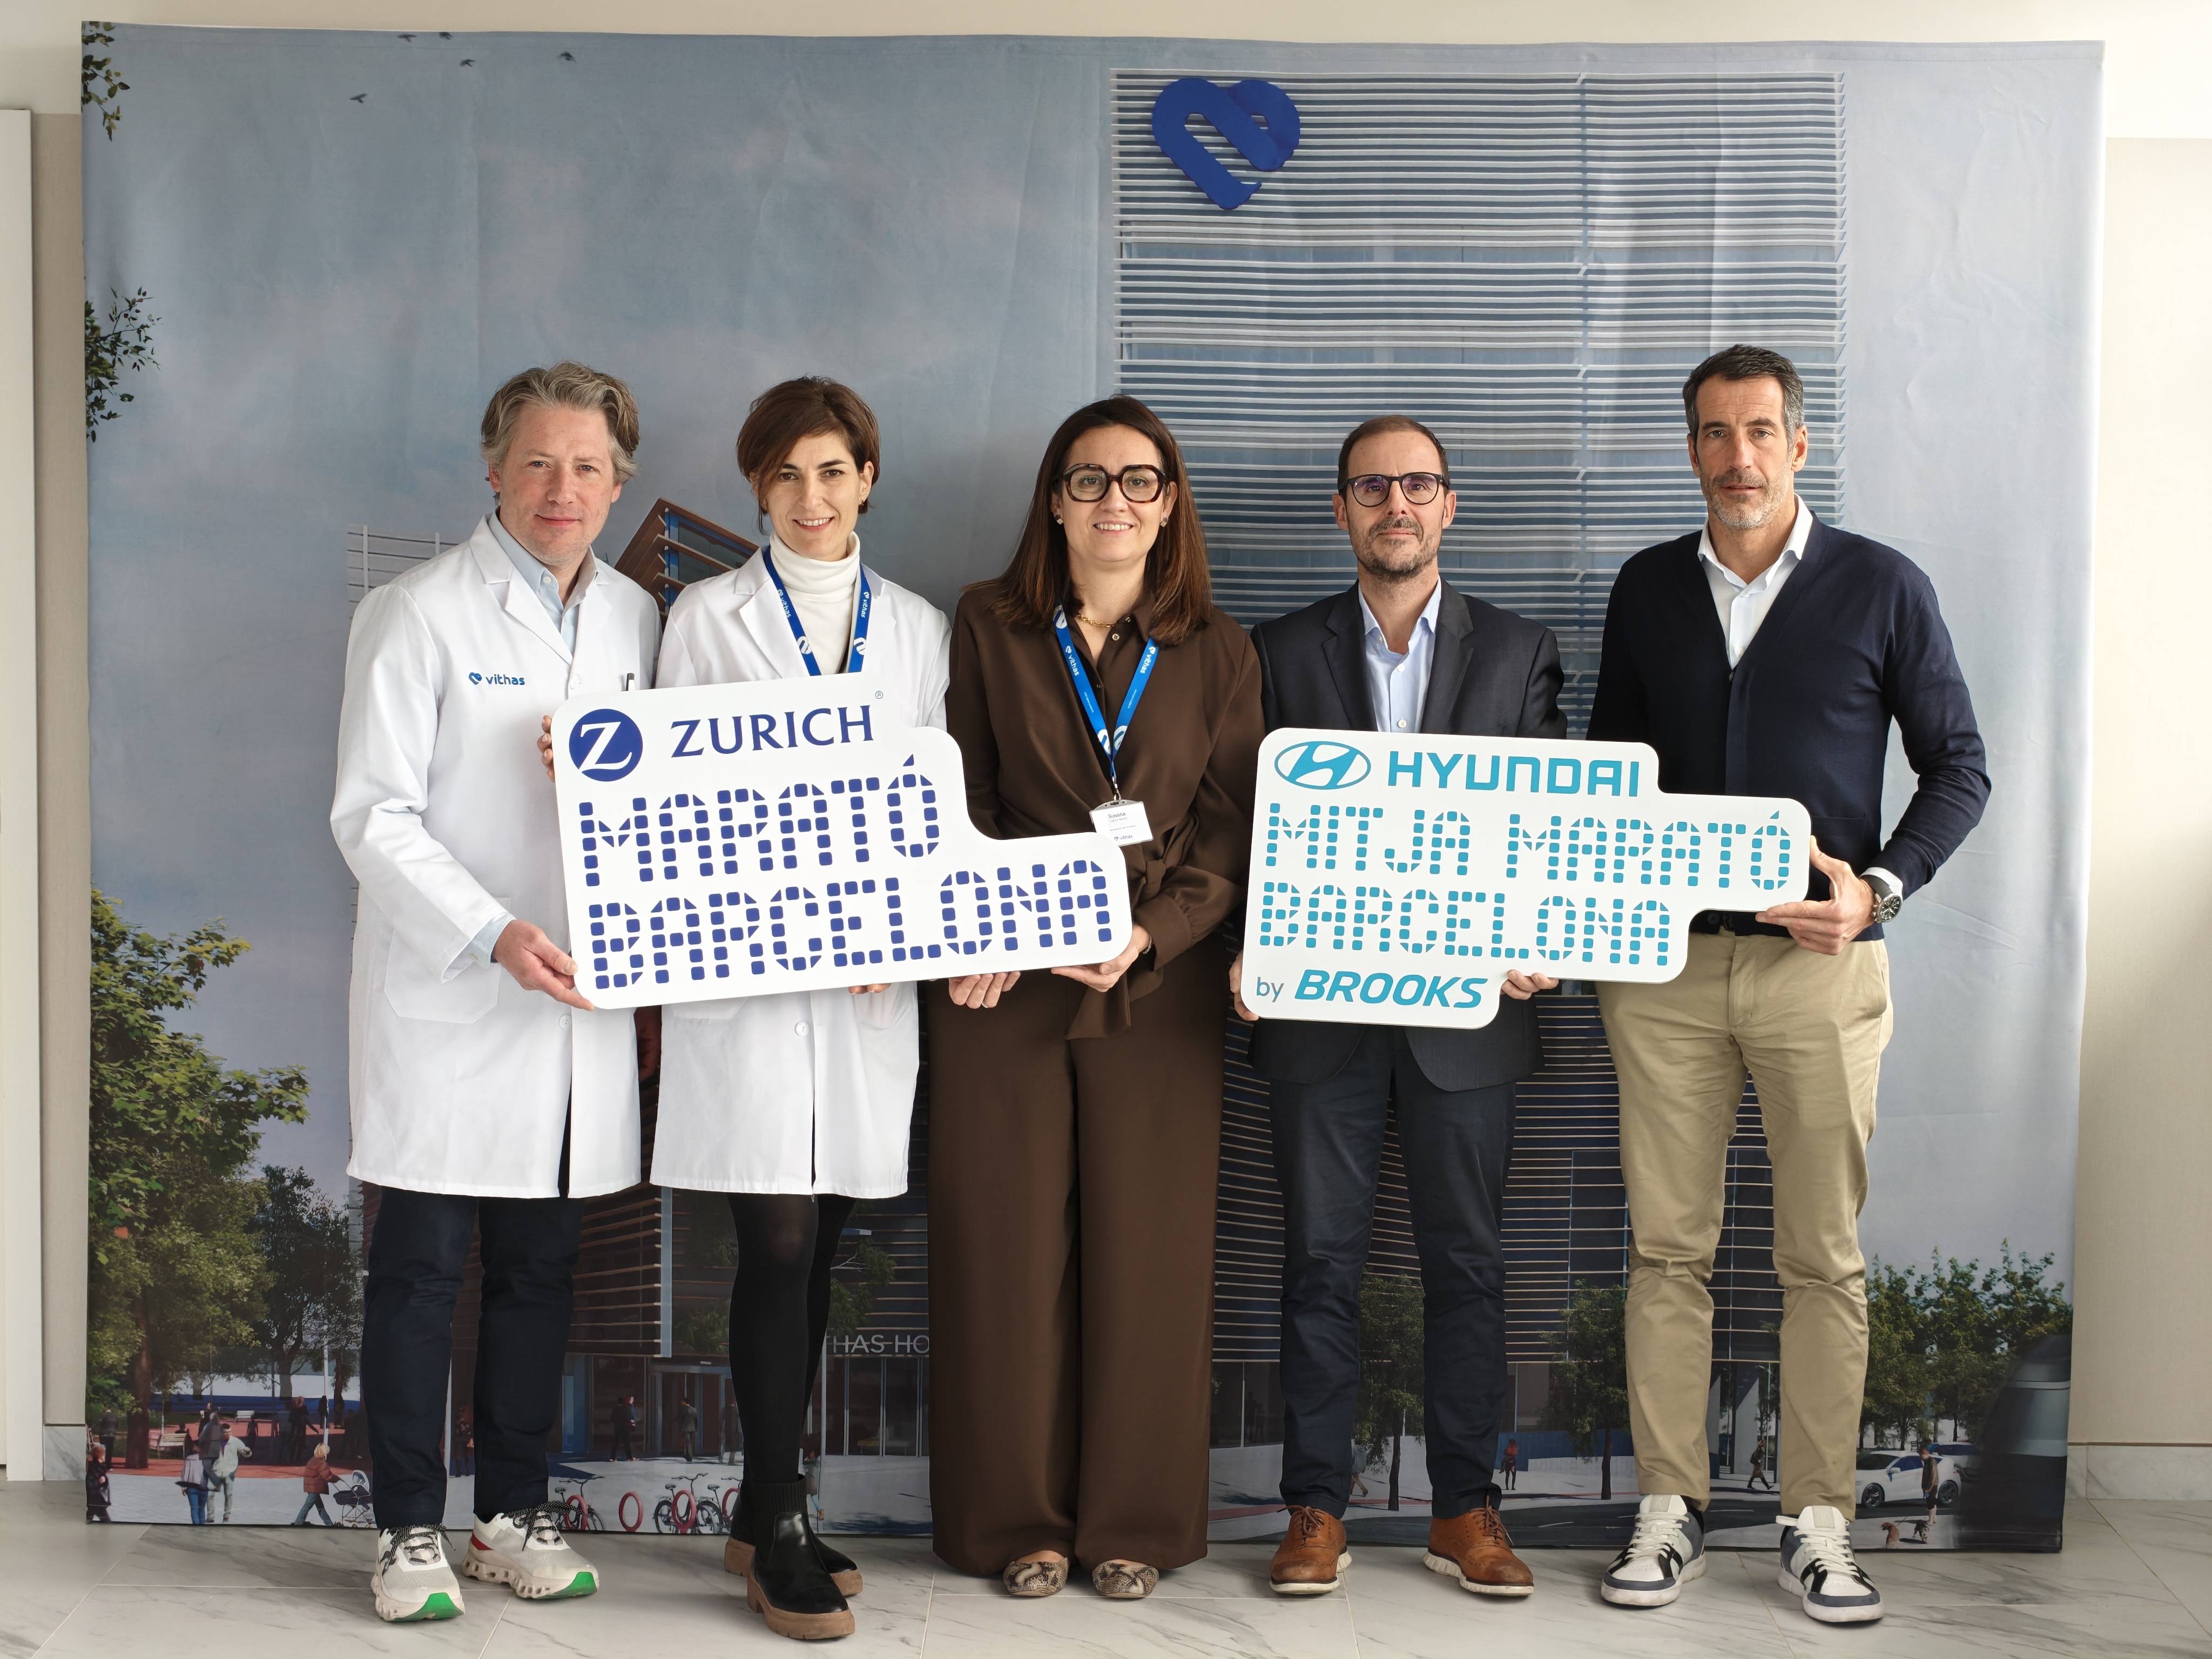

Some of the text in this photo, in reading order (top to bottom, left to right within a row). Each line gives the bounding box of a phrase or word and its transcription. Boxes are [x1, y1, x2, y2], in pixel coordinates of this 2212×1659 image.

[485, 675, 525, 686] vithas
[1068, 655, 1079, 676] vithas
[1140, 654, 1151, 675] vithas
[671, 705, 874, 758] ZURICH
[1388, 751, 1639, 797] HYUNDAI
[579, 754, 939, 886] MARATÓ
[1266, 803, 1790, 889] MITJA MARATÓ
[589, 860, 1112, 989] BARCELONA
[1259, 882, 1669, 966] BARCELONA
[1257, 969, 1488, 1008] by BROOKS
[827, 1334, 885, 1354] HAS
